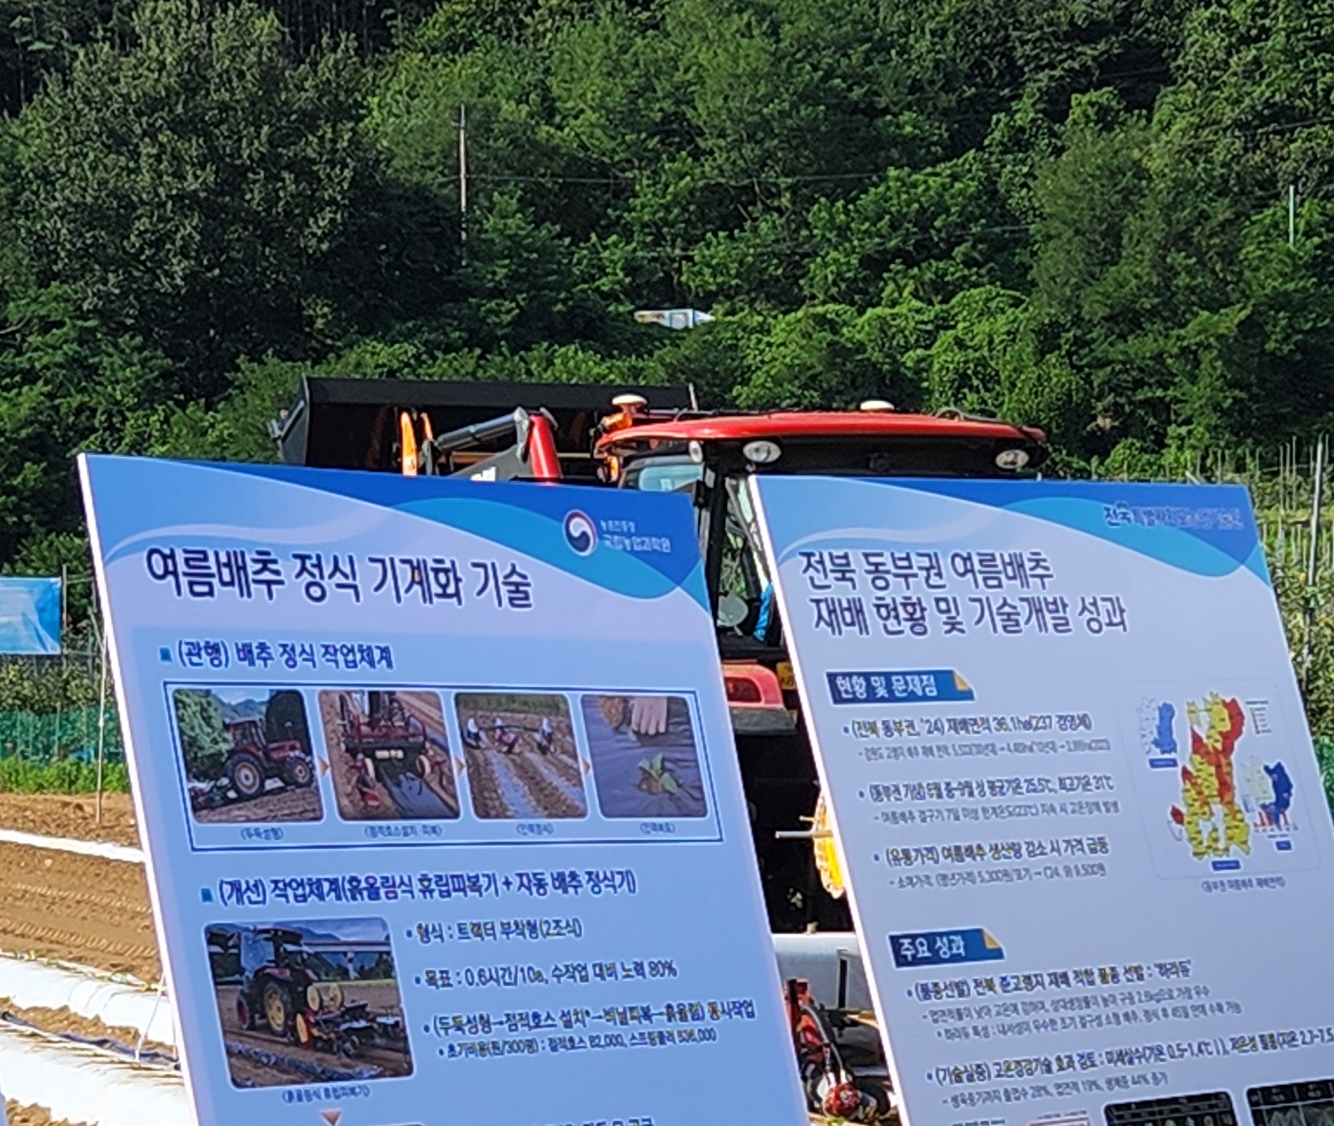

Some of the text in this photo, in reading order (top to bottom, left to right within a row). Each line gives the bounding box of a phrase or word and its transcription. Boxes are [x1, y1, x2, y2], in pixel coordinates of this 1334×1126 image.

[146, 546, 533, 609] 여름배추 정식 기계화 기술
[798, 550, 1054, 592] 전북 동부권 여름배추
[809, 596, 1128, 637] 재배 현황 및 기술개발 성과
[177, 640, 395, 670] (관행) 배추 정식 작업체계
[835, 674, 938, 699] 현황 및 문제점
[218, 878, 267, 907] (개선)
[516, 871, 548, 897] 자동
[552, 871, 584, 895] 배추
[586, 869, 637, 895] 정식기)
[898, 935, 966, 961] 주요 성과
[552, 963, 589, 984] 수작업
